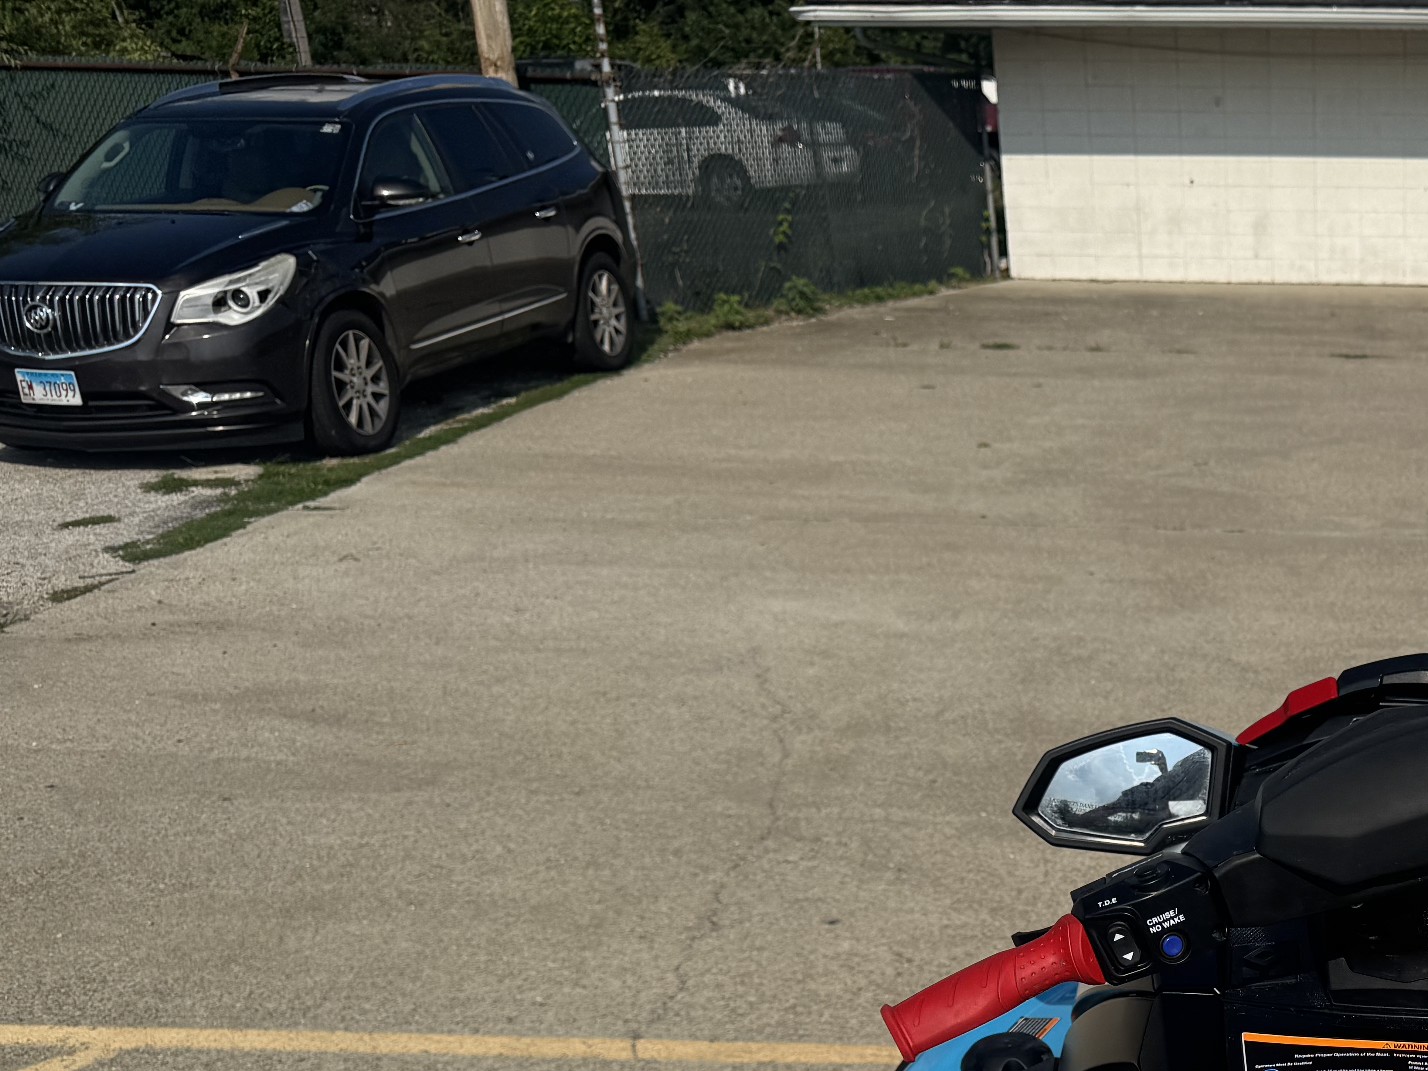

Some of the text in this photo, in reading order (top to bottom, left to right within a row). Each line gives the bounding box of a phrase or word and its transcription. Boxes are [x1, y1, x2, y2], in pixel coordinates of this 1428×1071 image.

[40, 381, 76, 399] 37099
[1147, 907, 1178, 926] CRUISE/
[1150, 914, 1186, 933] NO WAKE
